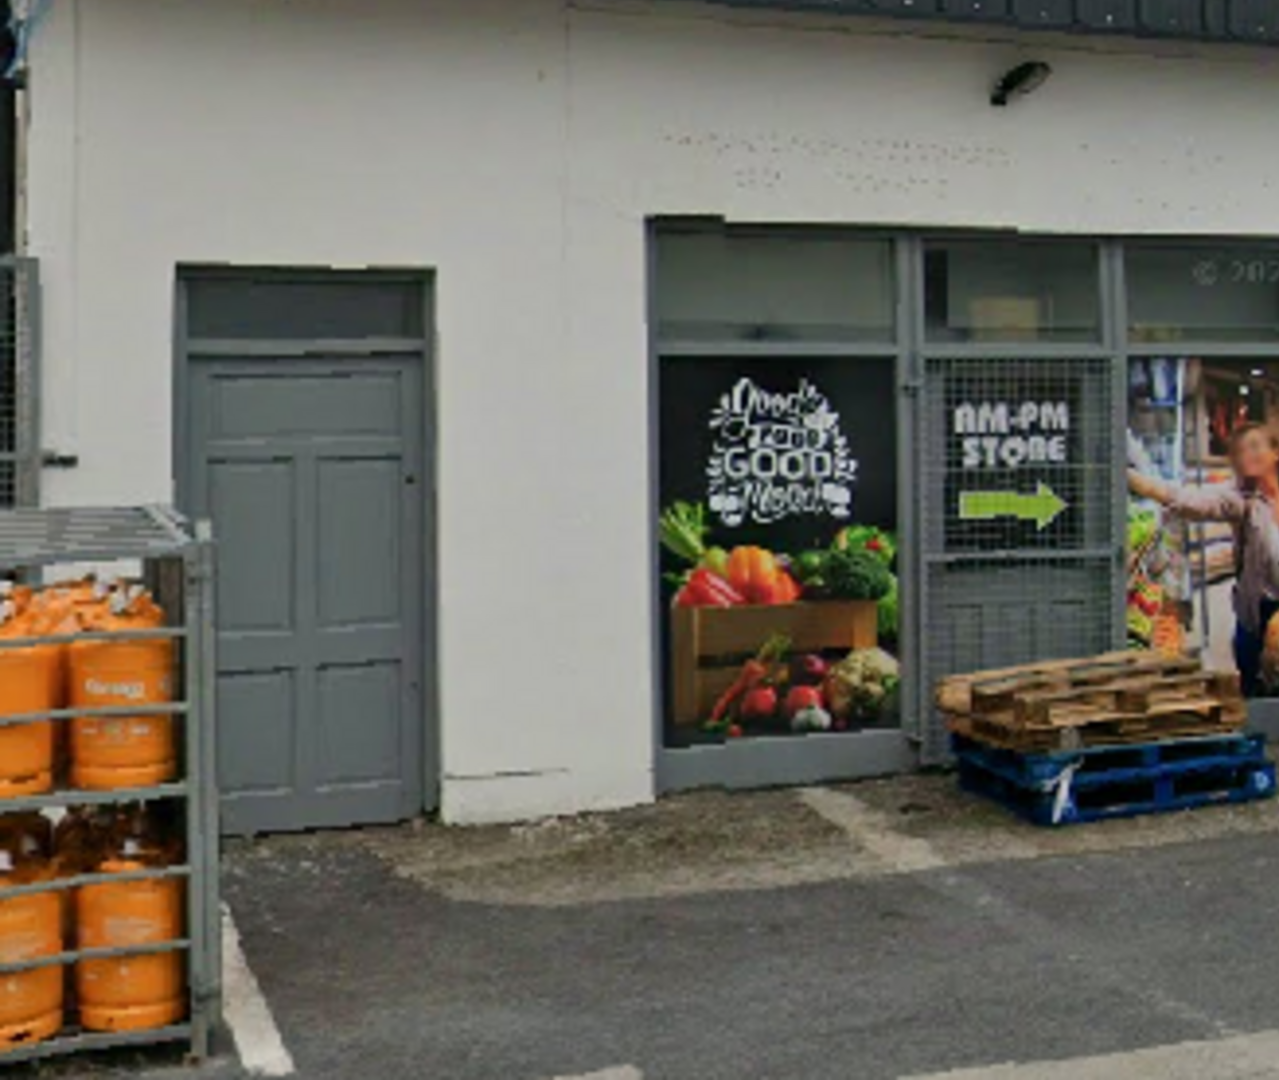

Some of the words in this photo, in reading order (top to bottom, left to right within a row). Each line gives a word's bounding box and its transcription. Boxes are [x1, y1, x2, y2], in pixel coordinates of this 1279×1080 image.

[954, 400, 1069, 434] AM-PM
[725, 446, 832, 480] GOOD
[962, 435, 1067, 468] STORE
